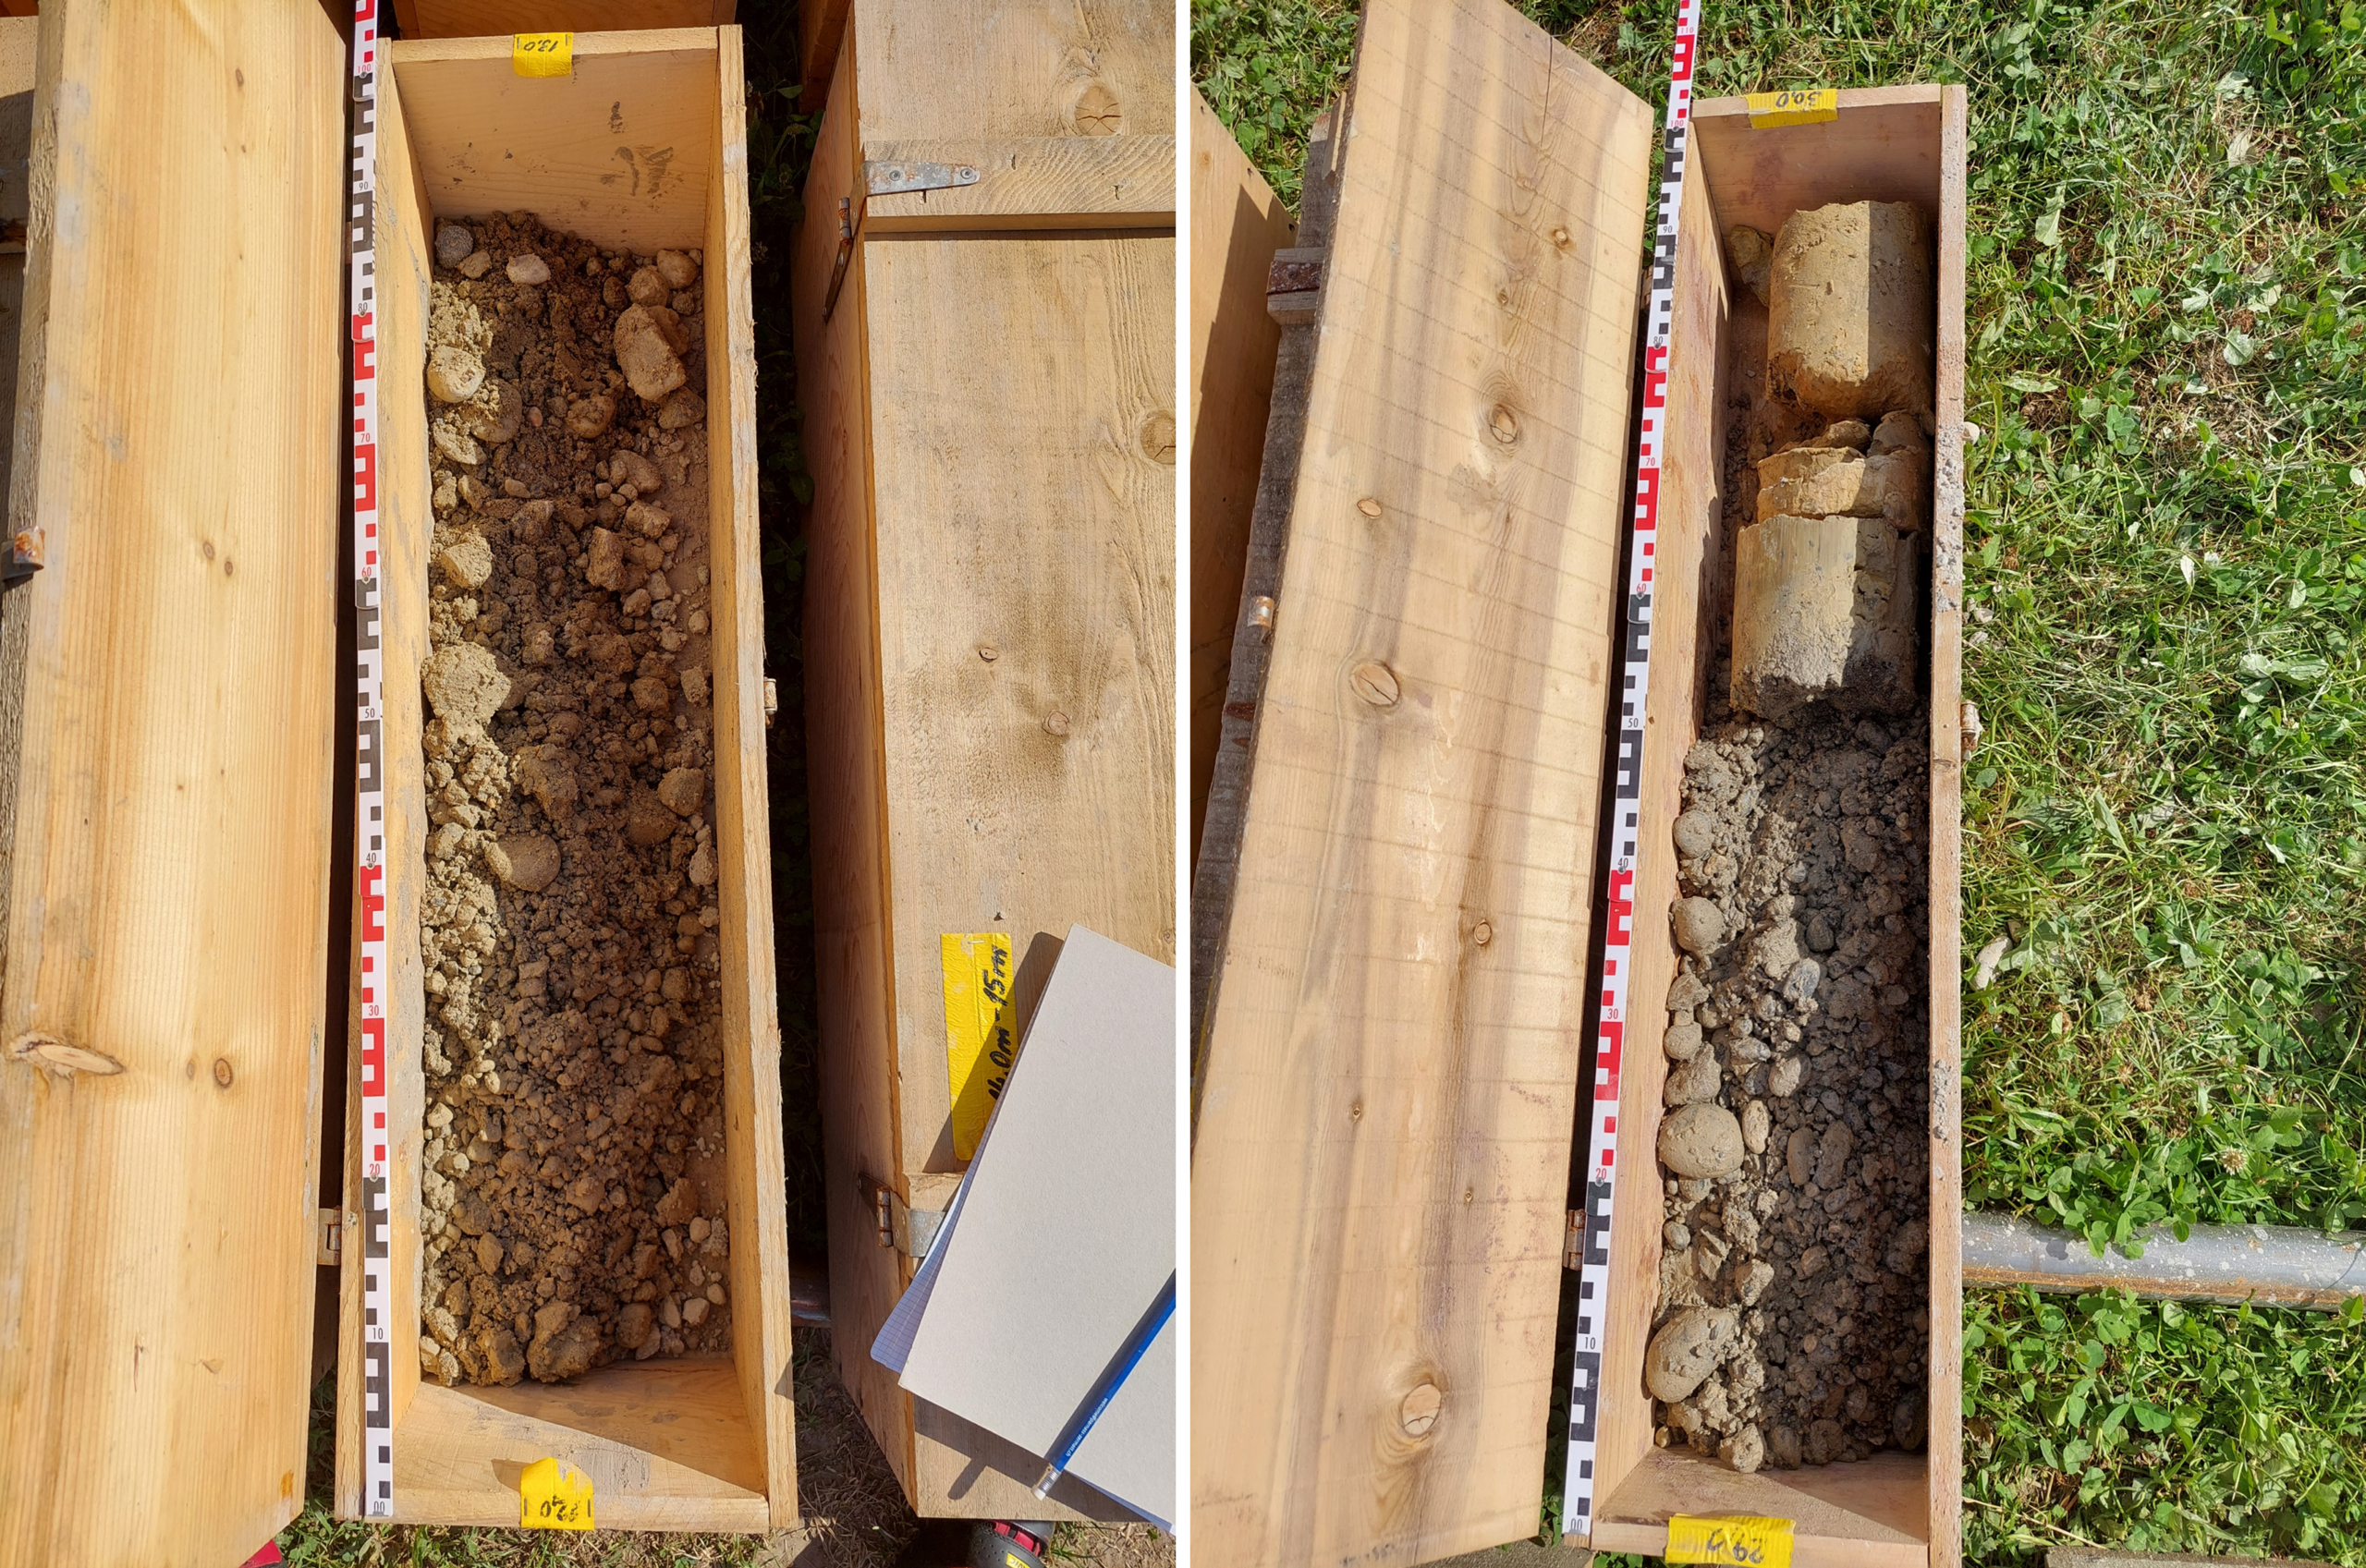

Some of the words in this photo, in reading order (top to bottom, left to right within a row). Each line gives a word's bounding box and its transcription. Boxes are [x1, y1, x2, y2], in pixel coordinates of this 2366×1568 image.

[523, 39, 559, 52] 13,0
[358, 64, 372, 73] 100
[1671, 119, 1684, 128] 100
[359, 182, 369, 191] 90
[1663, 225, 1673, 234] 90
[358, 302, 368, 311] 80
[1653, 336, 1663, 345] 80
[360, 432, 371, 443] 70
[1645, 457, 1655, 467] 70
[361, 566, 372, 577] 60
[1636, 583, 1647, 593] 60
[364, 708, 375, 718] 50
[1628, 717, 1639, 728] 50
[366, 853, 376, 863] 40
[1617, 857, 1628, 869] 40
[368, 1005, 379, 1016] 30
[1607, 1008, 1619, 1019] 30
[369, 1163, 381, 1175] 20
[1595, 1167, 1607, 1180] 20
[373, 1328, 384, 1340] 10
[1584, 1337, 1596, 1350] 10
[373, 1501, 385, 1513] 00
[1570, 1518, 1583, 1530] 00
